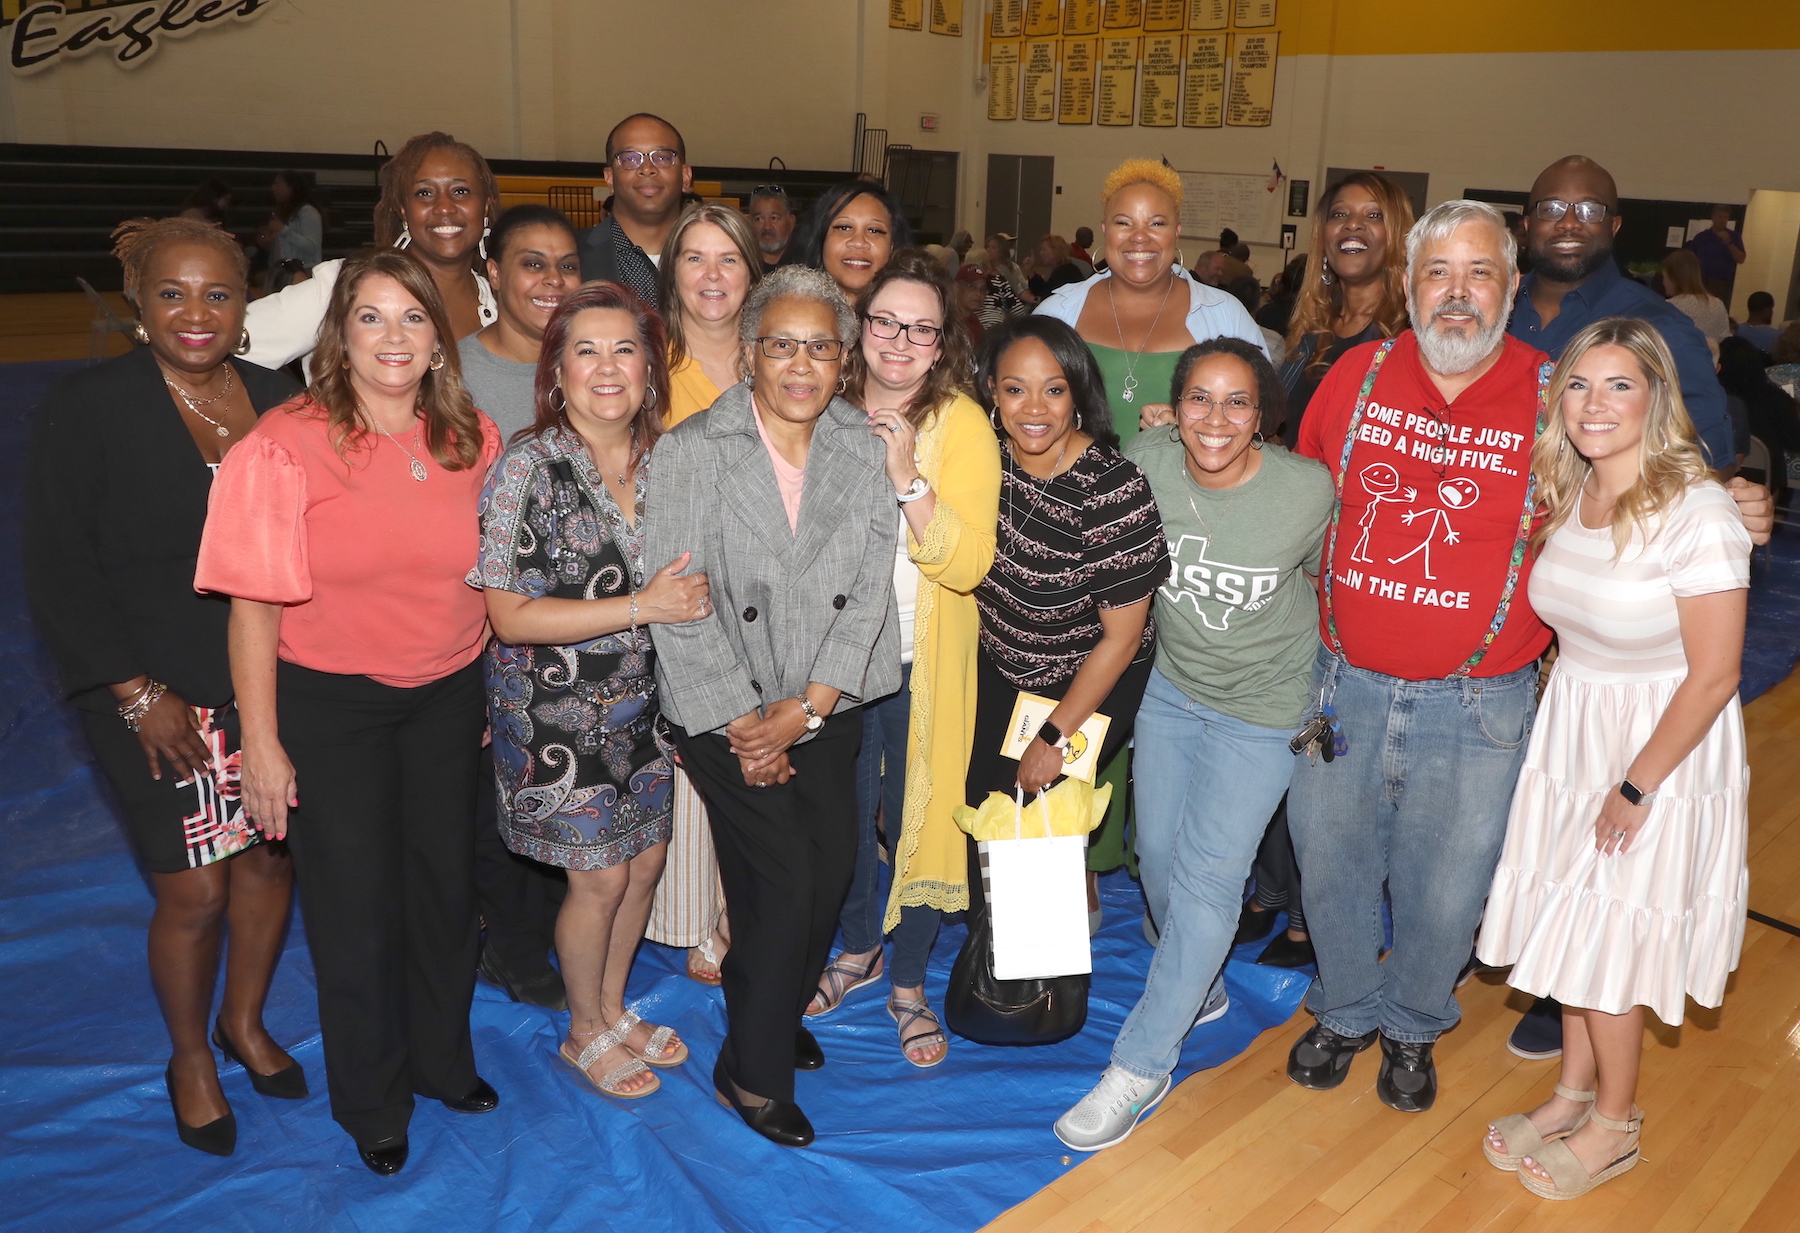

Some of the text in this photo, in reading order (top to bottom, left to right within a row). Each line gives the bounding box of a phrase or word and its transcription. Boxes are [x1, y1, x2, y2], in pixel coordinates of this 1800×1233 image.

[1404, 413, 1473, 444] PEOPLE
[1474, 428, 1524, 452] JUST
[1394, 435, 1407, 454] A
[1411, 439, 1458, 468] HIGH
[1459, 449, 1518, 477] FIVE...
[1369, 576, 1407, 601] THE
[1413, 586, 1471, 609] FACE
